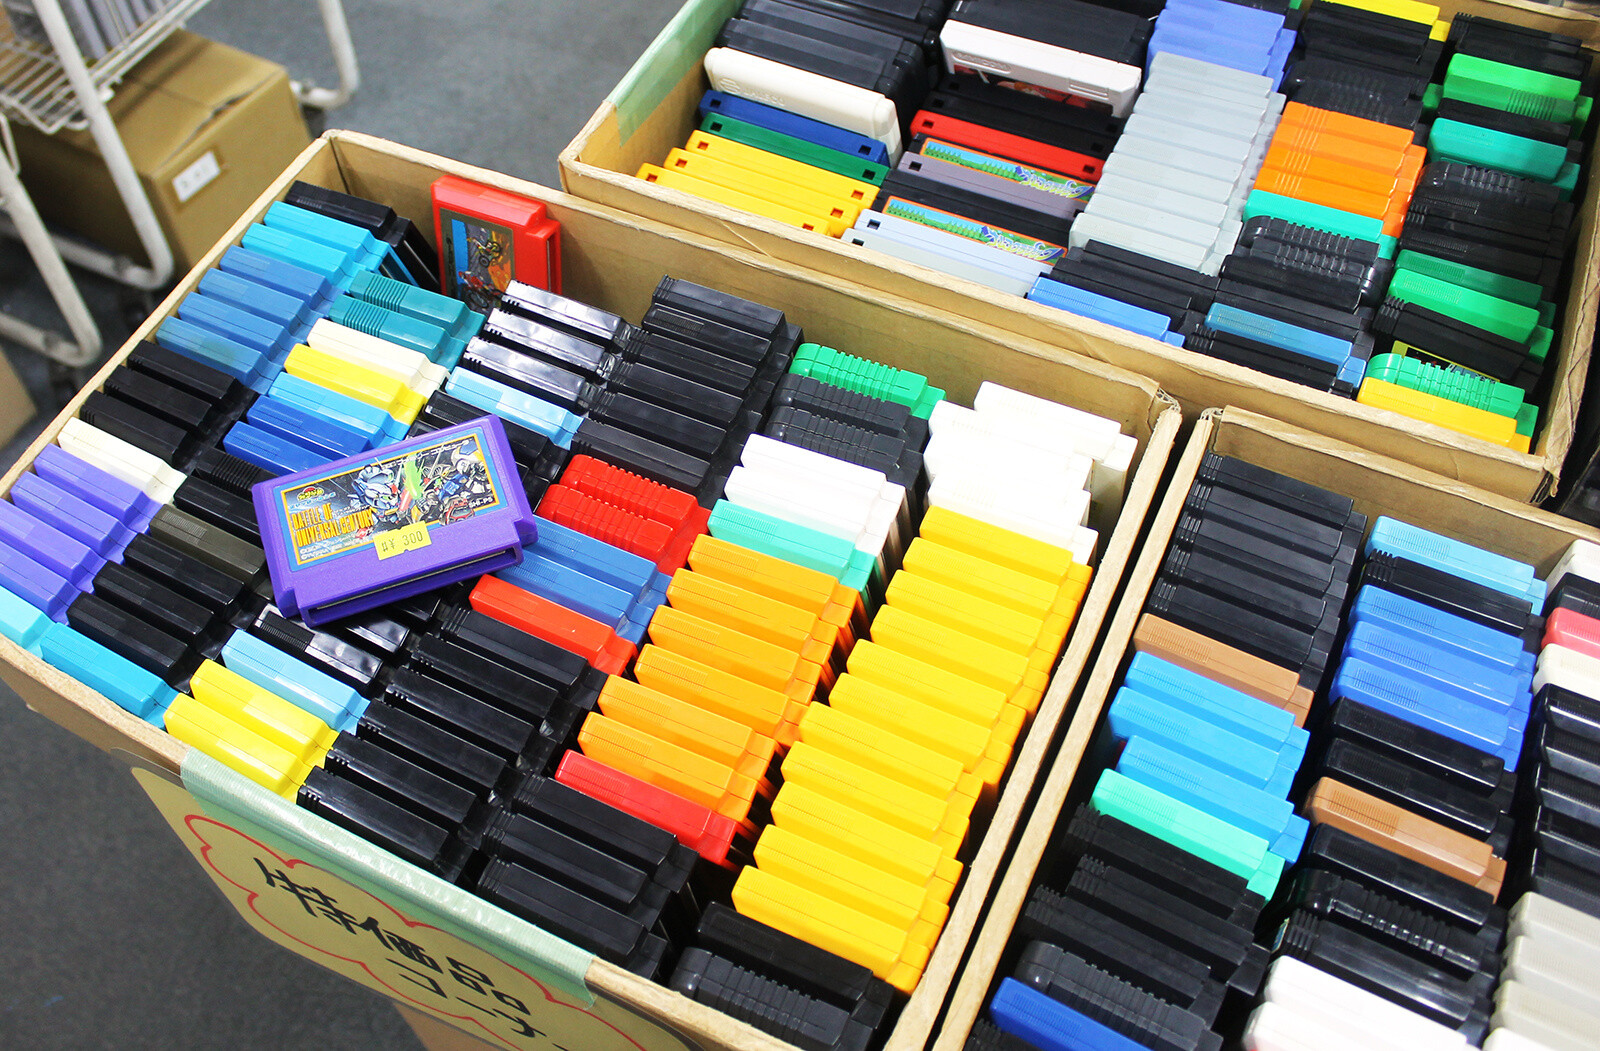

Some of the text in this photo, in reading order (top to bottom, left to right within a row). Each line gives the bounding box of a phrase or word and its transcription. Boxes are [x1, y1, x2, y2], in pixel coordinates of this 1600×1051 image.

[291, 506, 322, 531] BATTLE
[321, 502, 333, 521] OF
[295, 519, 341, 548] UNIVERSAL
[339, 508, 375, 535] CENTURY
[402, 530, 424, 547] 300
[253, 857, 531, 1016] 特価品
[385, 957, 569, 1051] コーナ
